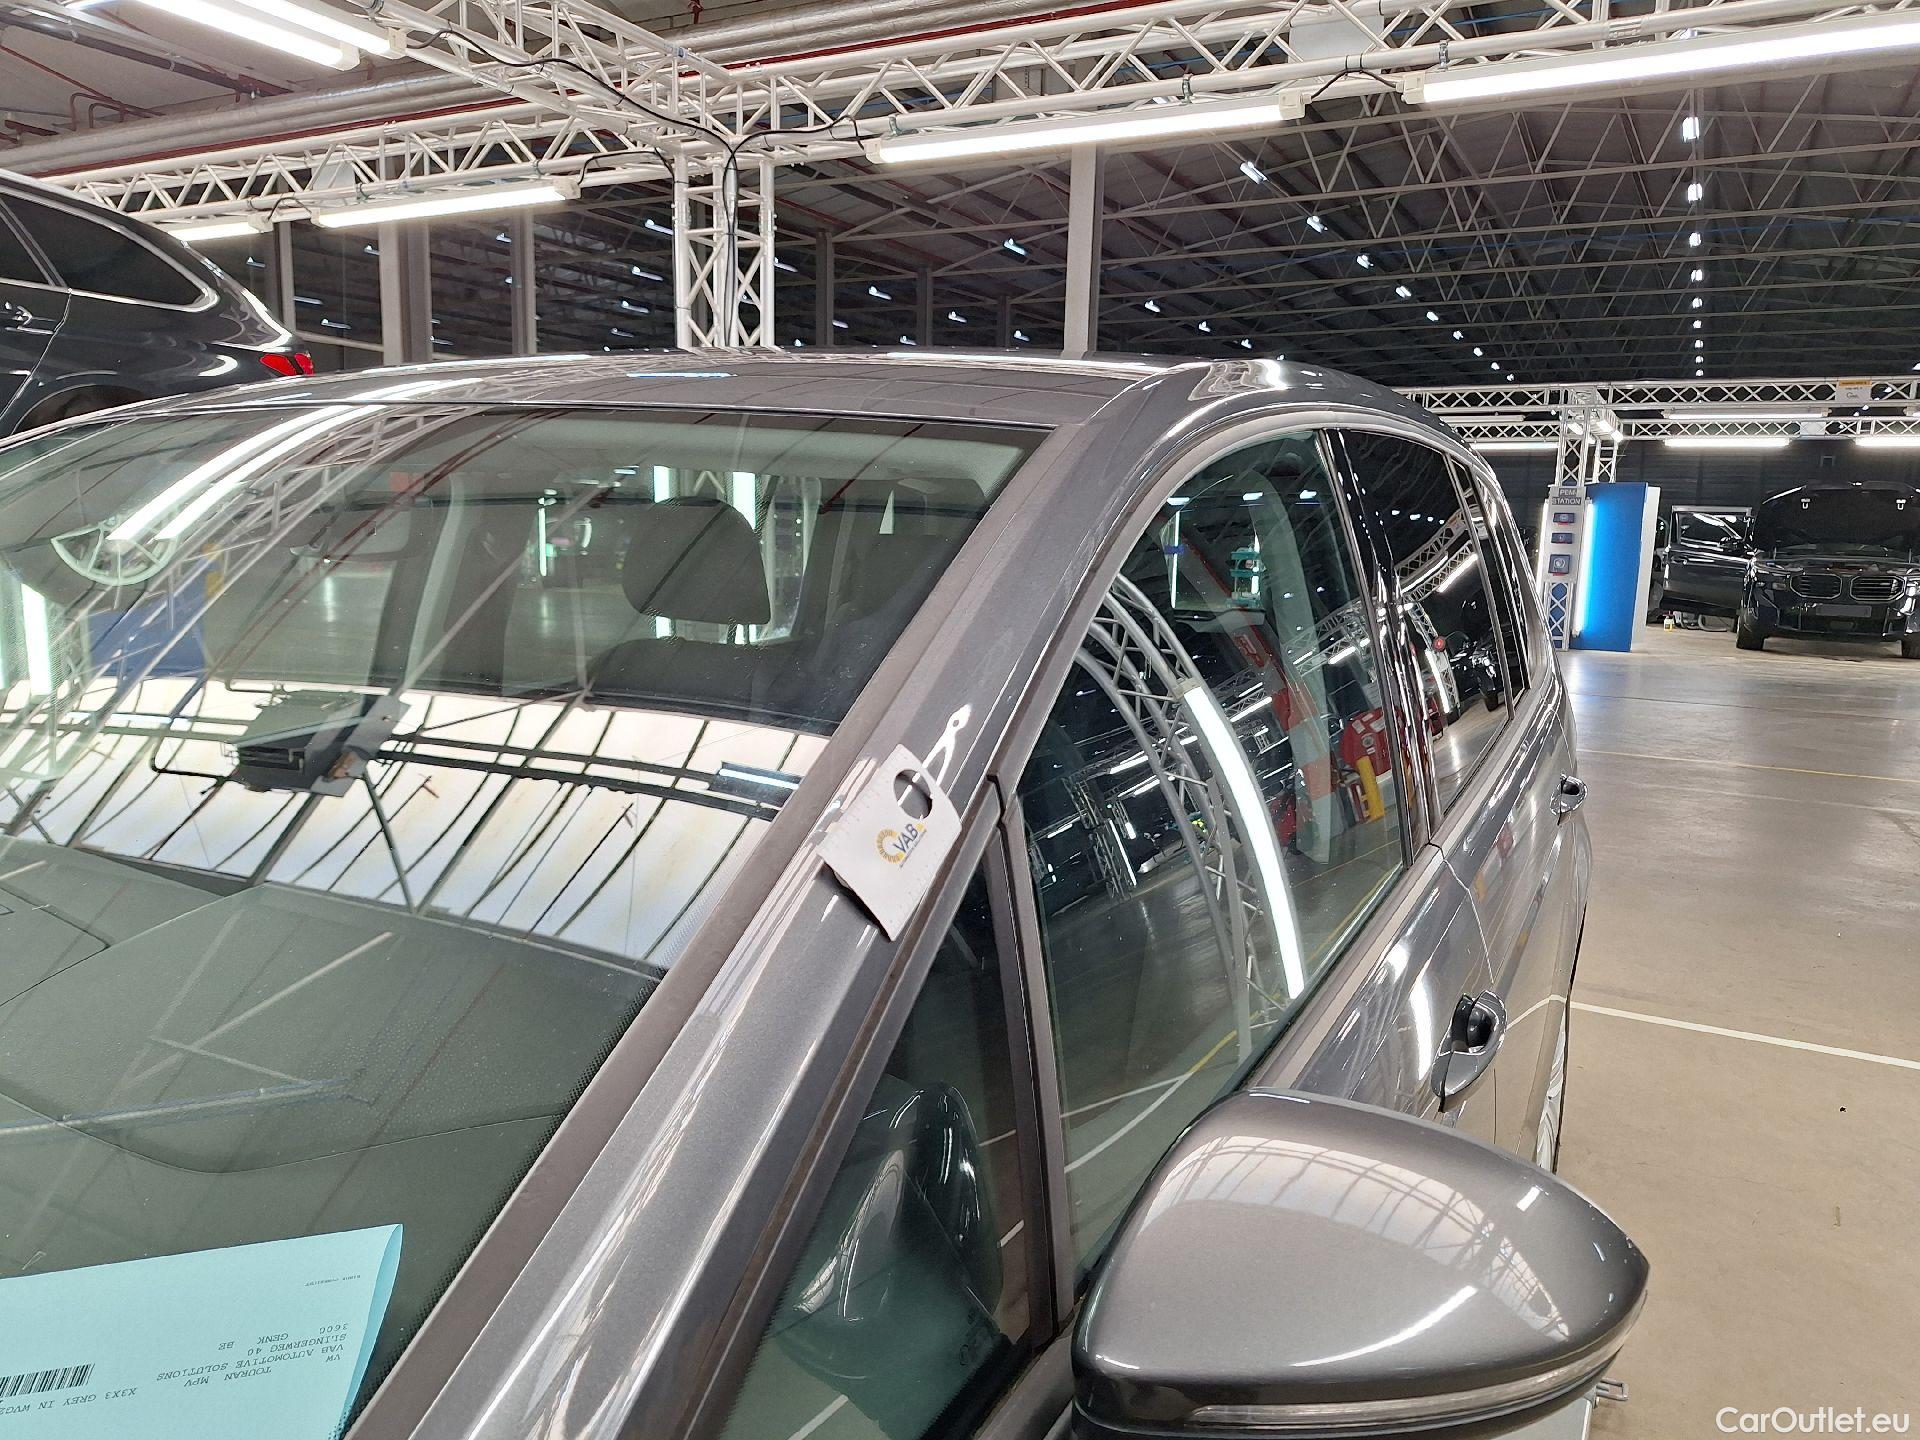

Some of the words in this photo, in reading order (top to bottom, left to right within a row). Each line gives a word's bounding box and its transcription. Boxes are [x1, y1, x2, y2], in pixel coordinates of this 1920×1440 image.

[1552, 497, 1580, 505] STATION
[893, 823, 919, 853] VAB
[256, 1332, 289, 1344] GENK
[269, 1333, 347, 1353] SLINGERWEG
[217, 1340, 235, 1351] BE
[247, 1347, 262, 1356] 40
[321, 1343, 344, 1354] VAB
[235, 1348, 314, 1369] AUTOMOTIVE
[325, 1353, 341, 1362] VW
[156, 1363, 229, 1381] SOLUTIONS
[224, 1366, 272, 1381] TOURAN
[183, 1376, 210, 1387] MPV
[104, 1387, 138, 1400] X3X3
[37, 1400, 55, 1410] IN
[62, 1394, 97, 1407] GREY
